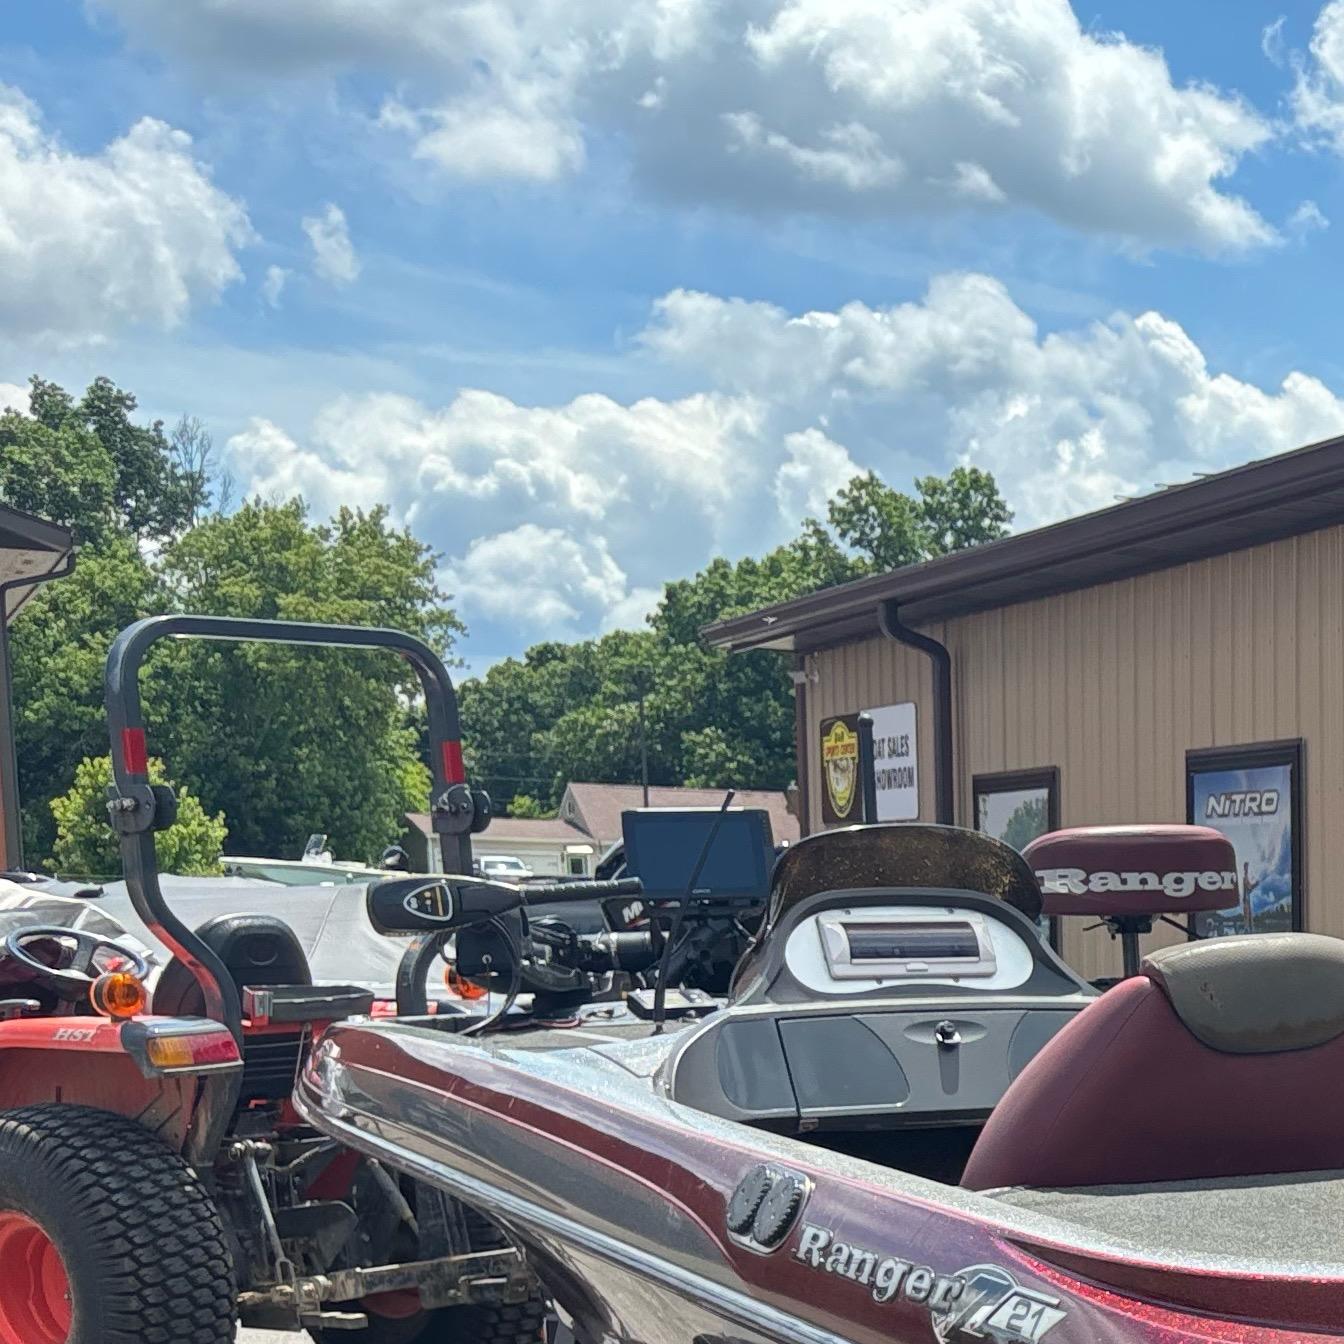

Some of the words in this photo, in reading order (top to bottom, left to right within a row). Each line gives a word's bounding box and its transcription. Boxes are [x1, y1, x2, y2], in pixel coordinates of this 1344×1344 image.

[873, 738, 886, 760] OAT
[887, 734, 910, 758] SALES
[876, 766, 914, 791] HOWROOM
[1035, 868, 1237, 898] Ranger
[792, 1222, 966, 1312] Ranger
